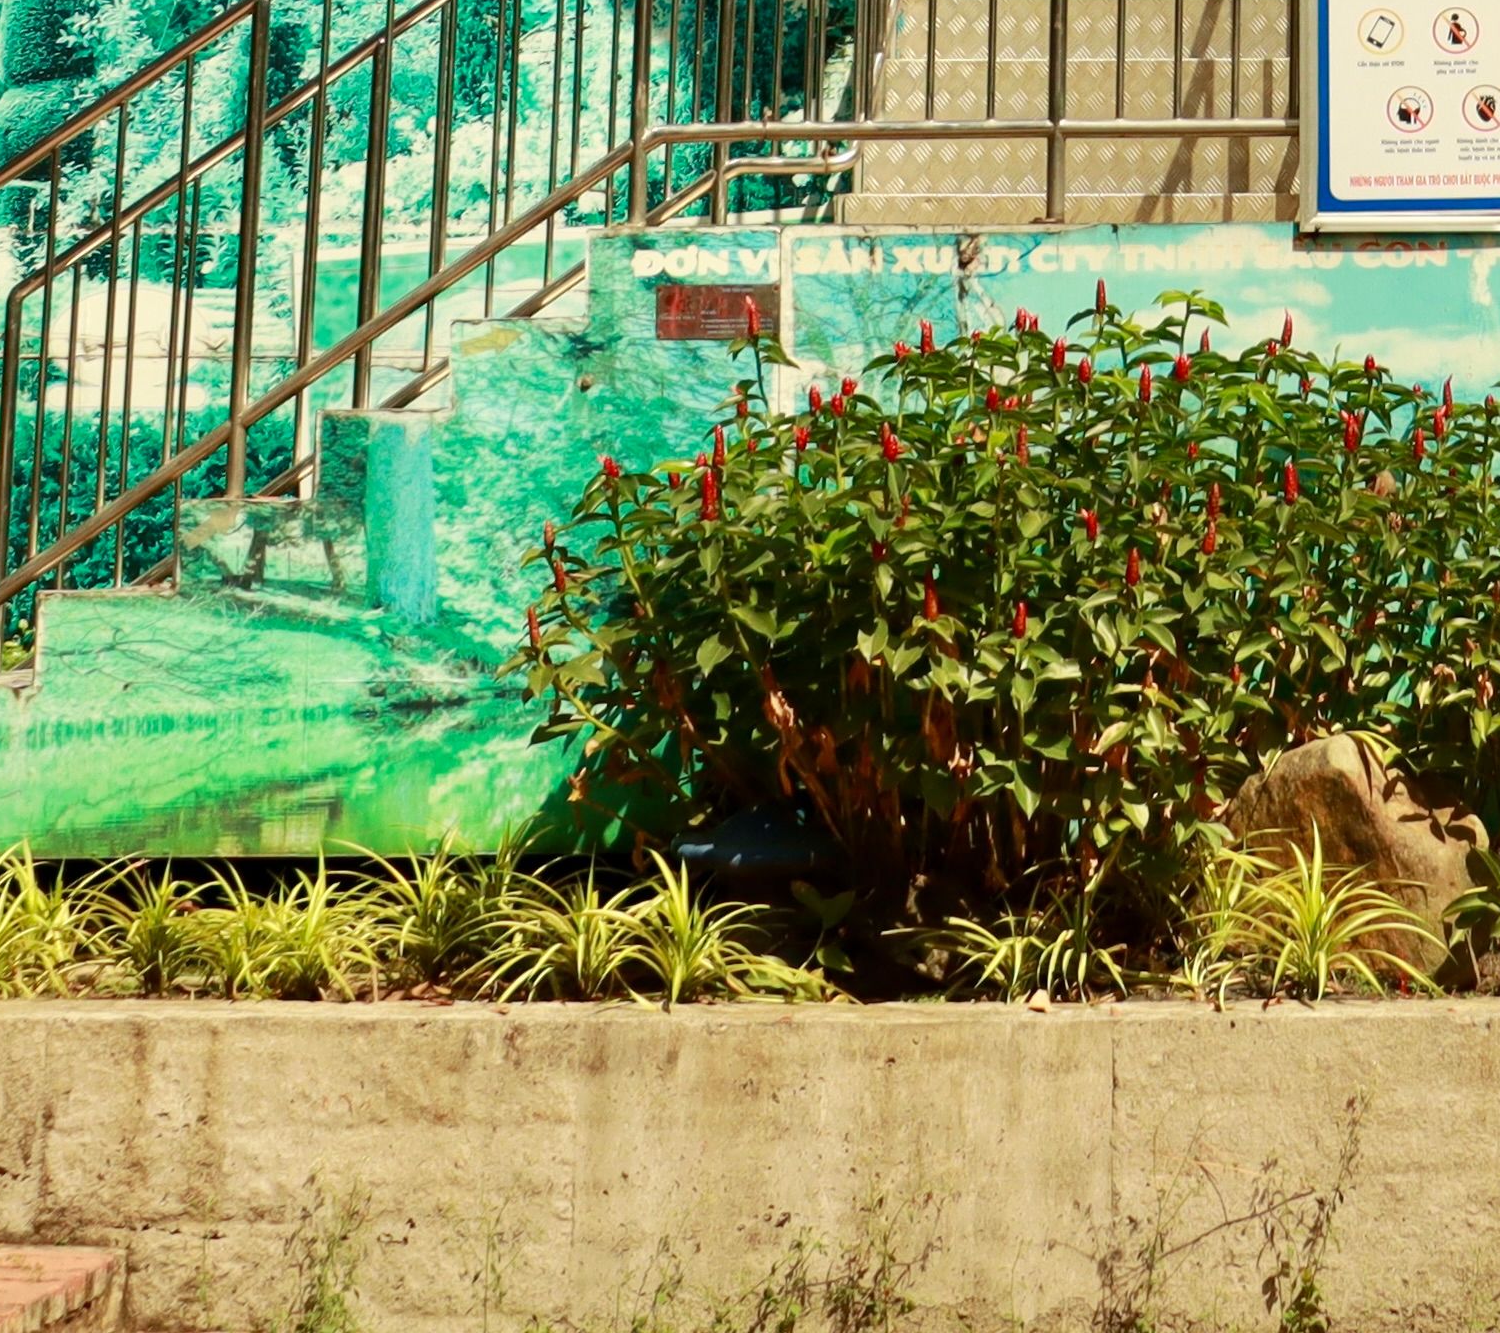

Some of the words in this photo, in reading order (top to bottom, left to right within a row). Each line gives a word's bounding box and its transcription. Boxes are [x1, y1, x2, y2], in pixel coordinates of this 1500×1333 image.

[631, 245, 731, 278] ĐƠN
[1028, 244, 1112, 273] CTY
[1353, 240, 1447, 270] CON
